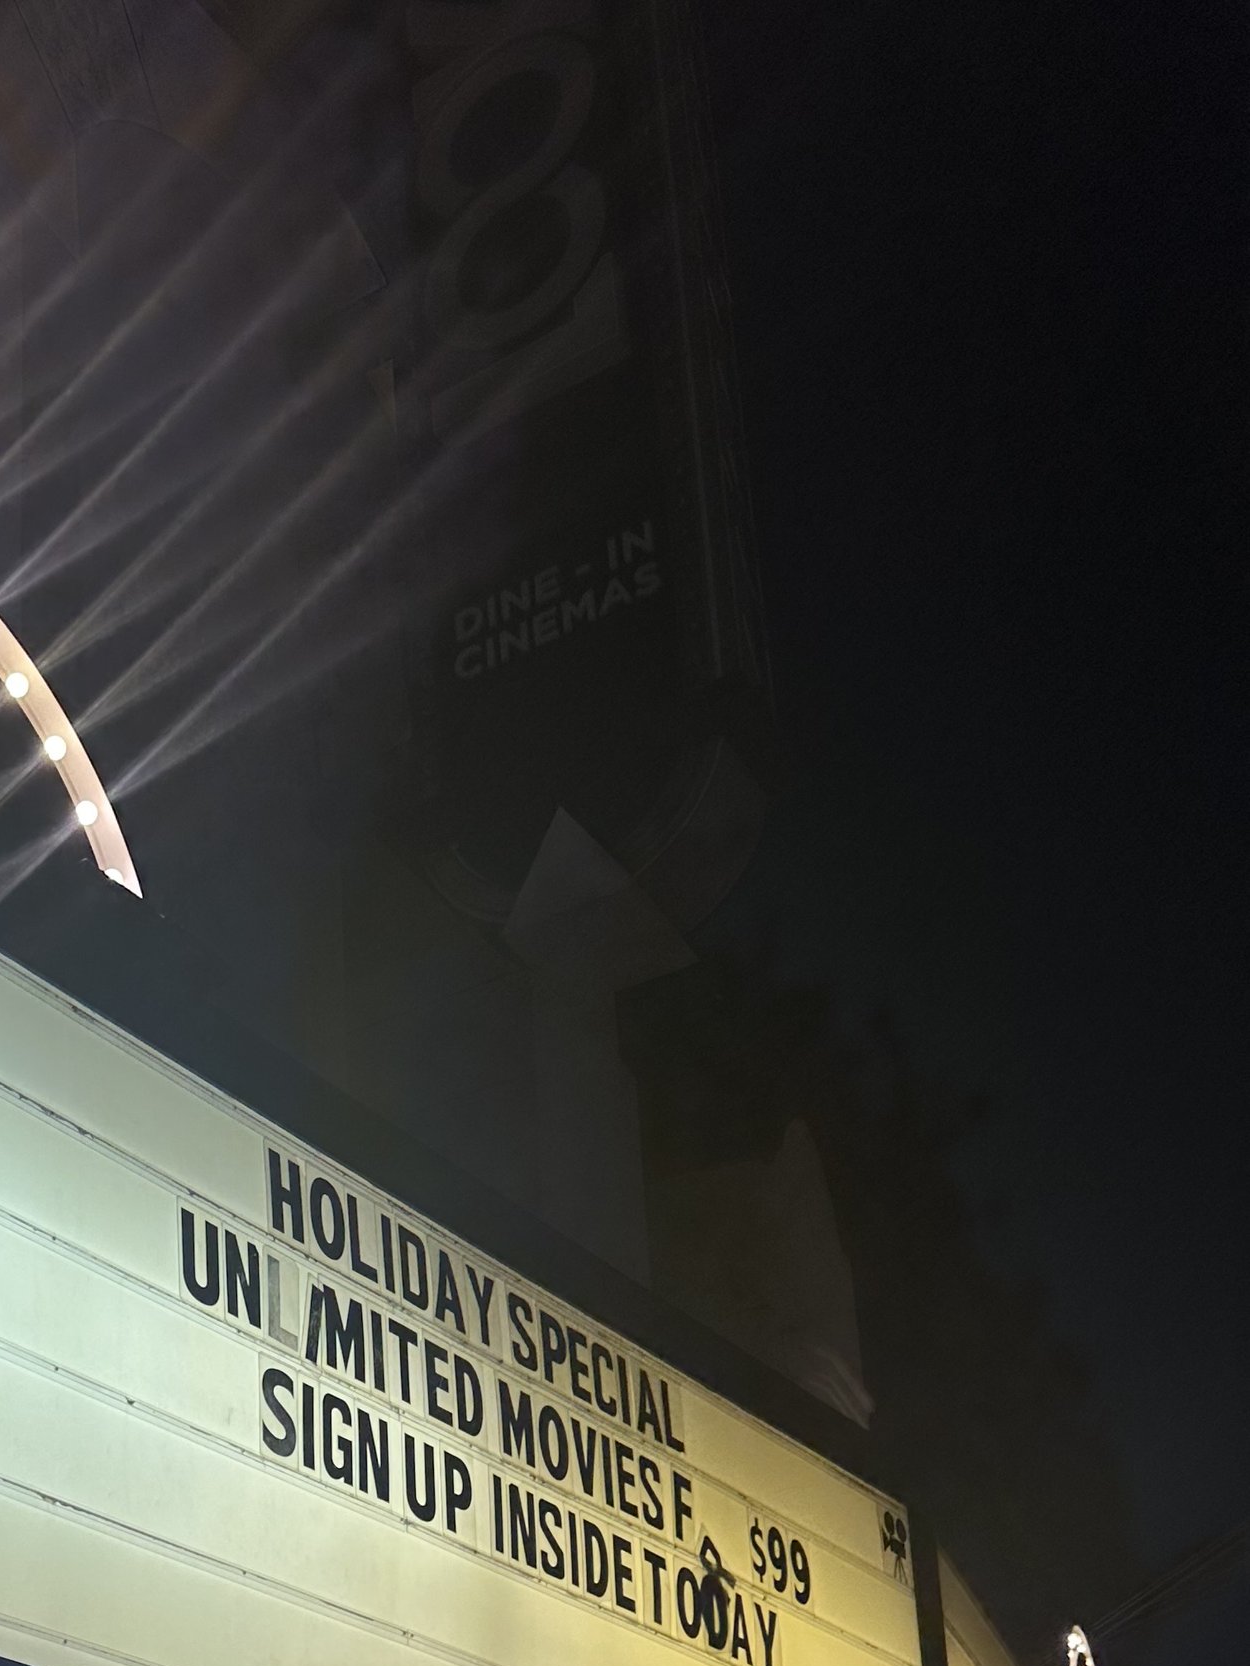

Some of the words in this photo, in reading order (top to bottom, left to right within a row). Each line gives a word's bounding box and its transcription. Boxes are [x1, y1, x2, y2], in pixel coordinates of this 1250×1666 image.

[453, 561, 662, 680] CINEMAS
[454, 565, 561, 643] DINE
[181, 1206, 484, 1437] UNLIMITED
[498, 1378, 665, 1531] MOVIES
[750, 1517, 812, 1605] $99
[268, 1147, 494, 1347] HOLIDAY
[508, 1292, 686, 1454] SPECIAL
[261, 1367, 391, 1504] SIGN
[404, 1432, 473, 1534] UP
[492, 1473, 637, 1615] INSIDE
